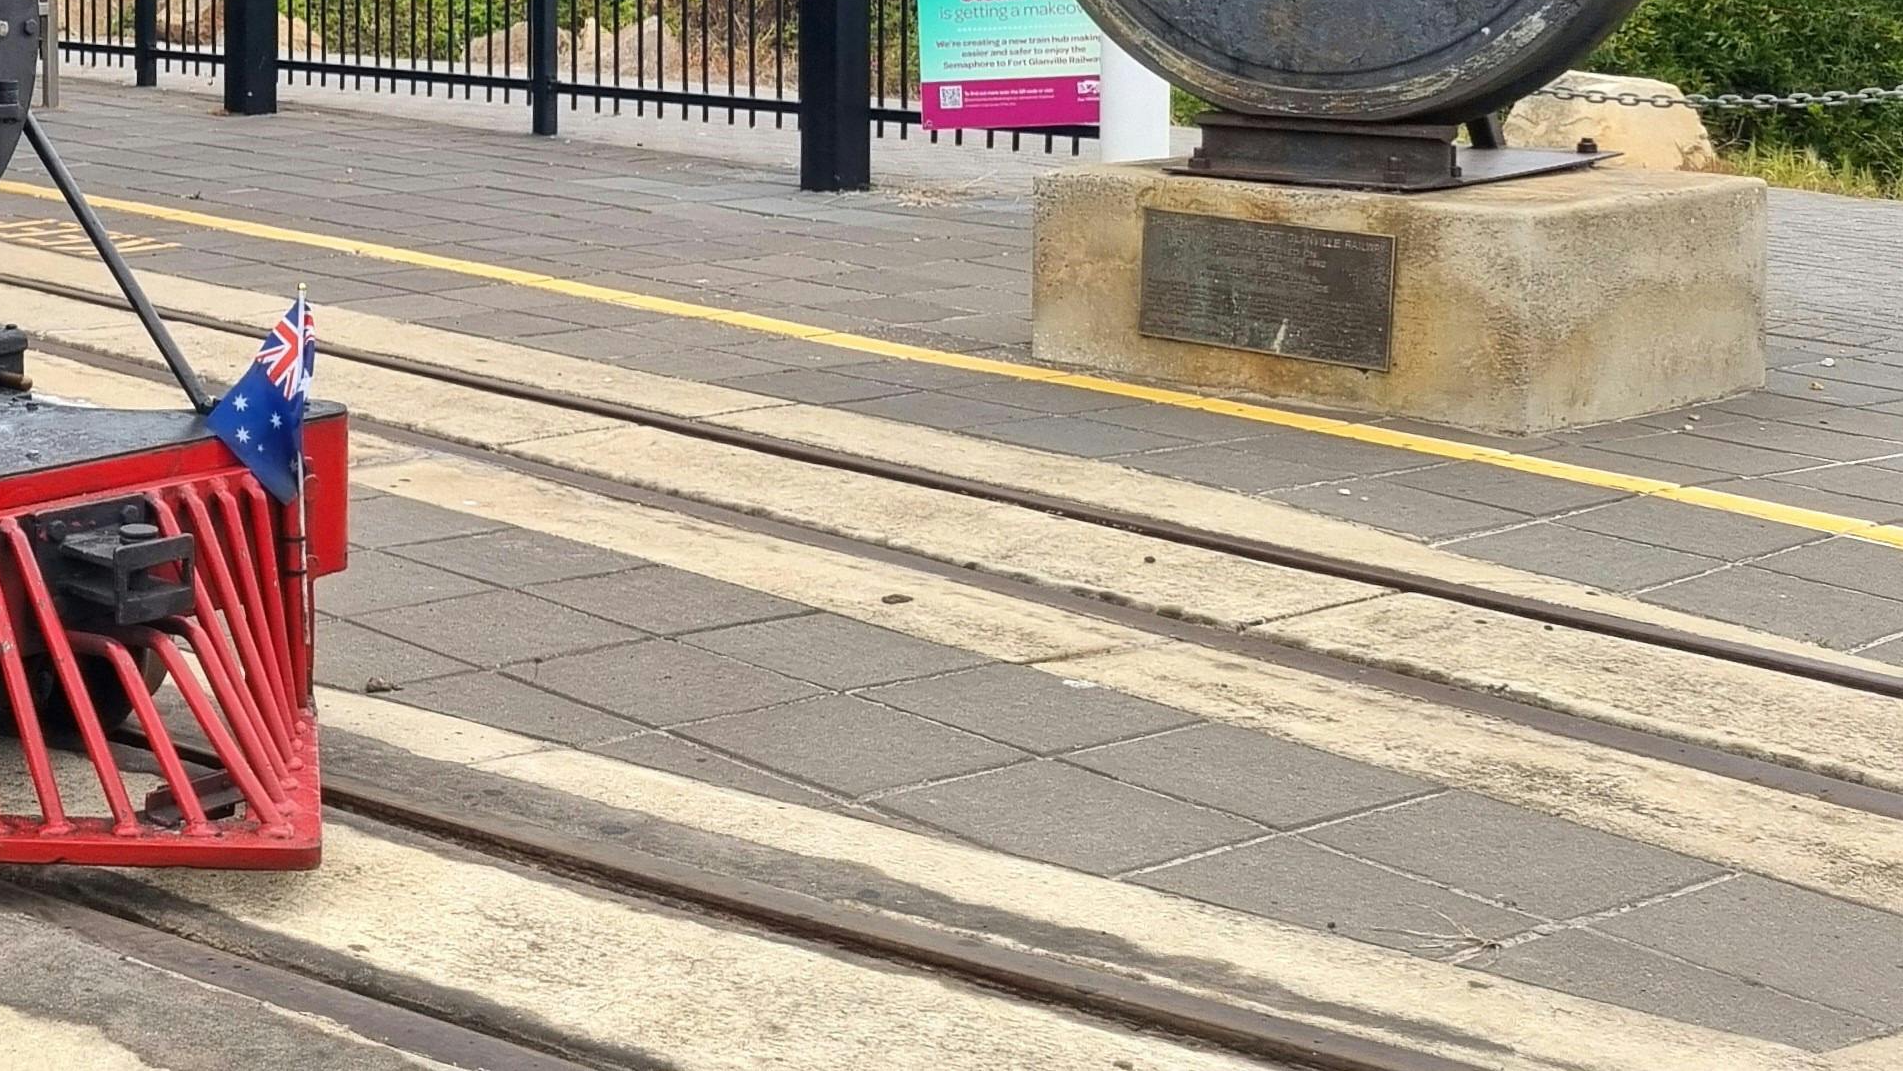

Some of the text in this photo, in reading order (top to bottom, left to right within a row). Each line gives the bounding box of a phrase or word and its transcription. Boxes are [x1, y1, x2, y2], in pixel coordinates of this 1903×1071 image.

[940, 2, 1083, 23] is getting a makeov
[936, 40, 961, 48] We're
[963, 38, 1000, 47] creating
[962, 50, 987, 58] easier
[990, 48, 1007, 56] and
[1009, 47, 1031, 56] safer
[1045, 46, 1069, 56] enjoy
[1071, 45, 1086, 53] the
[943, 55, 1101, 70] Semaphore to Fort Glanville Railwa
